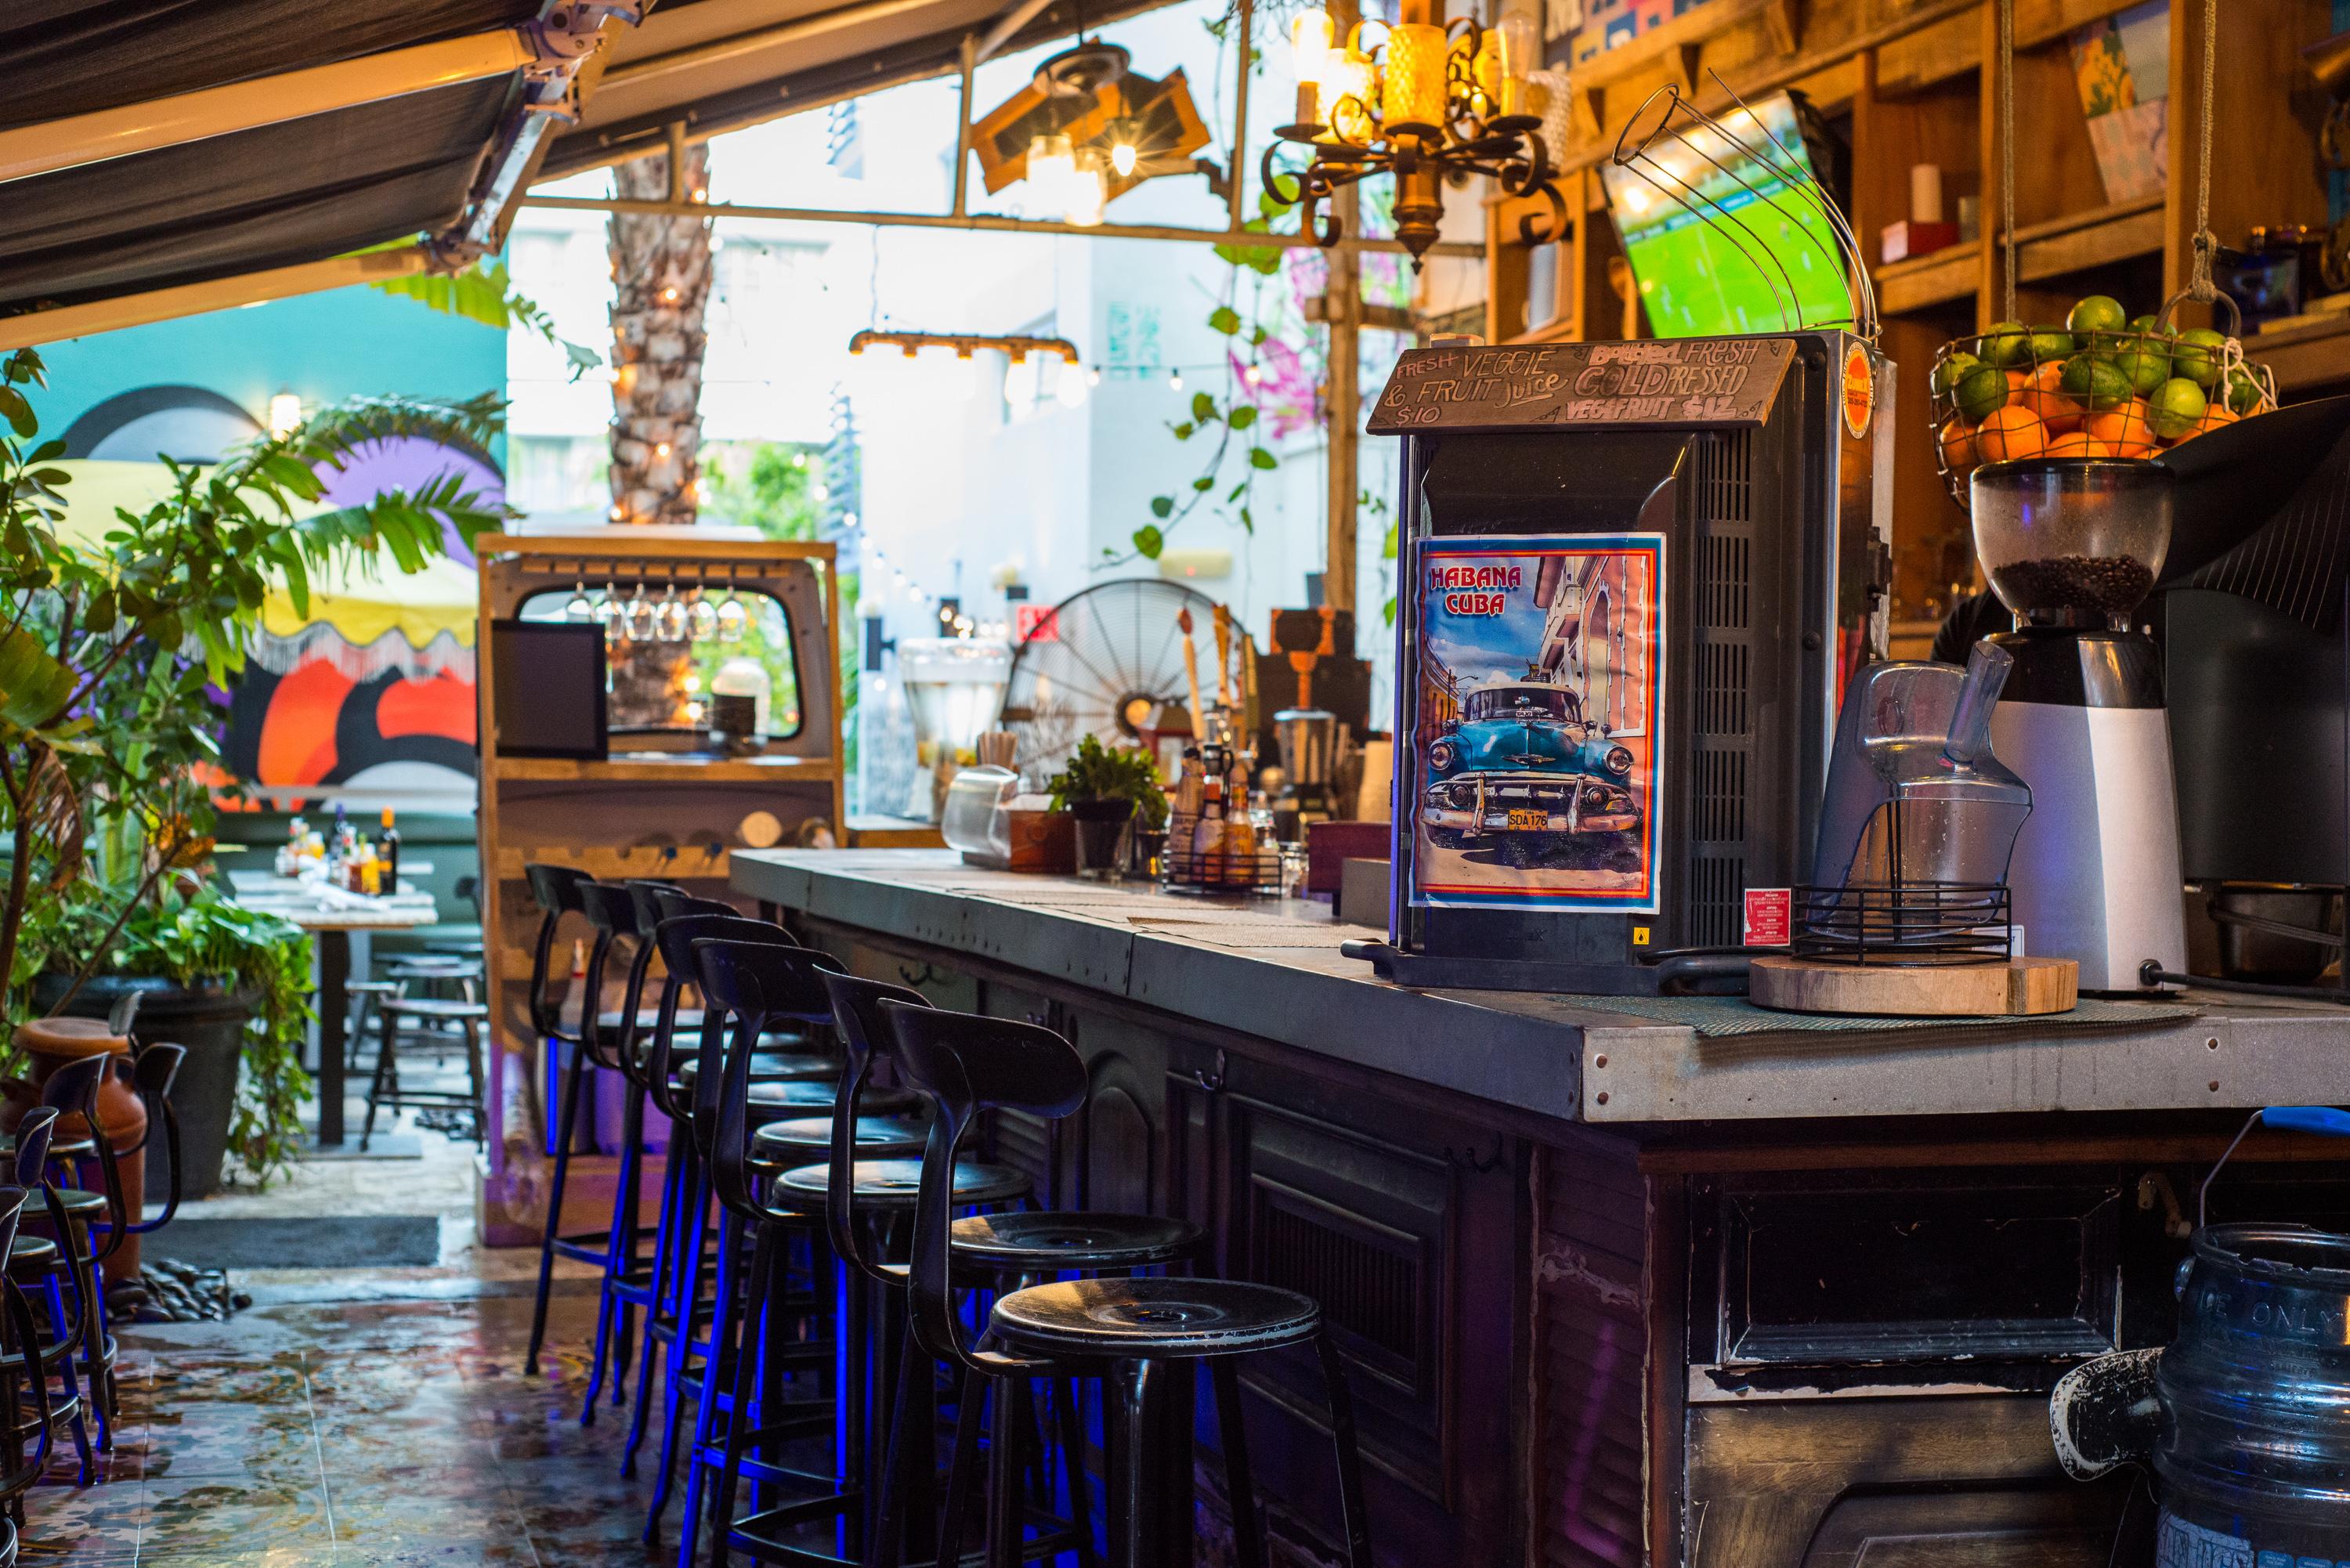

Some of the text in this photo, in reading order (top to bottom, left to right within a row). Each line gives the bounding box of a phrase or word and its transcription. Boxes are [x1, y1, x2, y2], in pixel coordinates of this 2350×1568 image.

[1396, 351, 1557, 379] FRESH VEGGIE
[1383, 385, 1407, 407] &
[1416, 378, 1503, 403] FRUIT
[1394, 405, 1442, 427] $10
[1681, 394, 1738, 419] $12
[1430, 565, 1522, 590] HABANA
[1445, 593, 1506, 616] CUBA
[1509, 814, 1548, 826] SDA 176
[2252, 1302, 2344, 1337] ONLY
